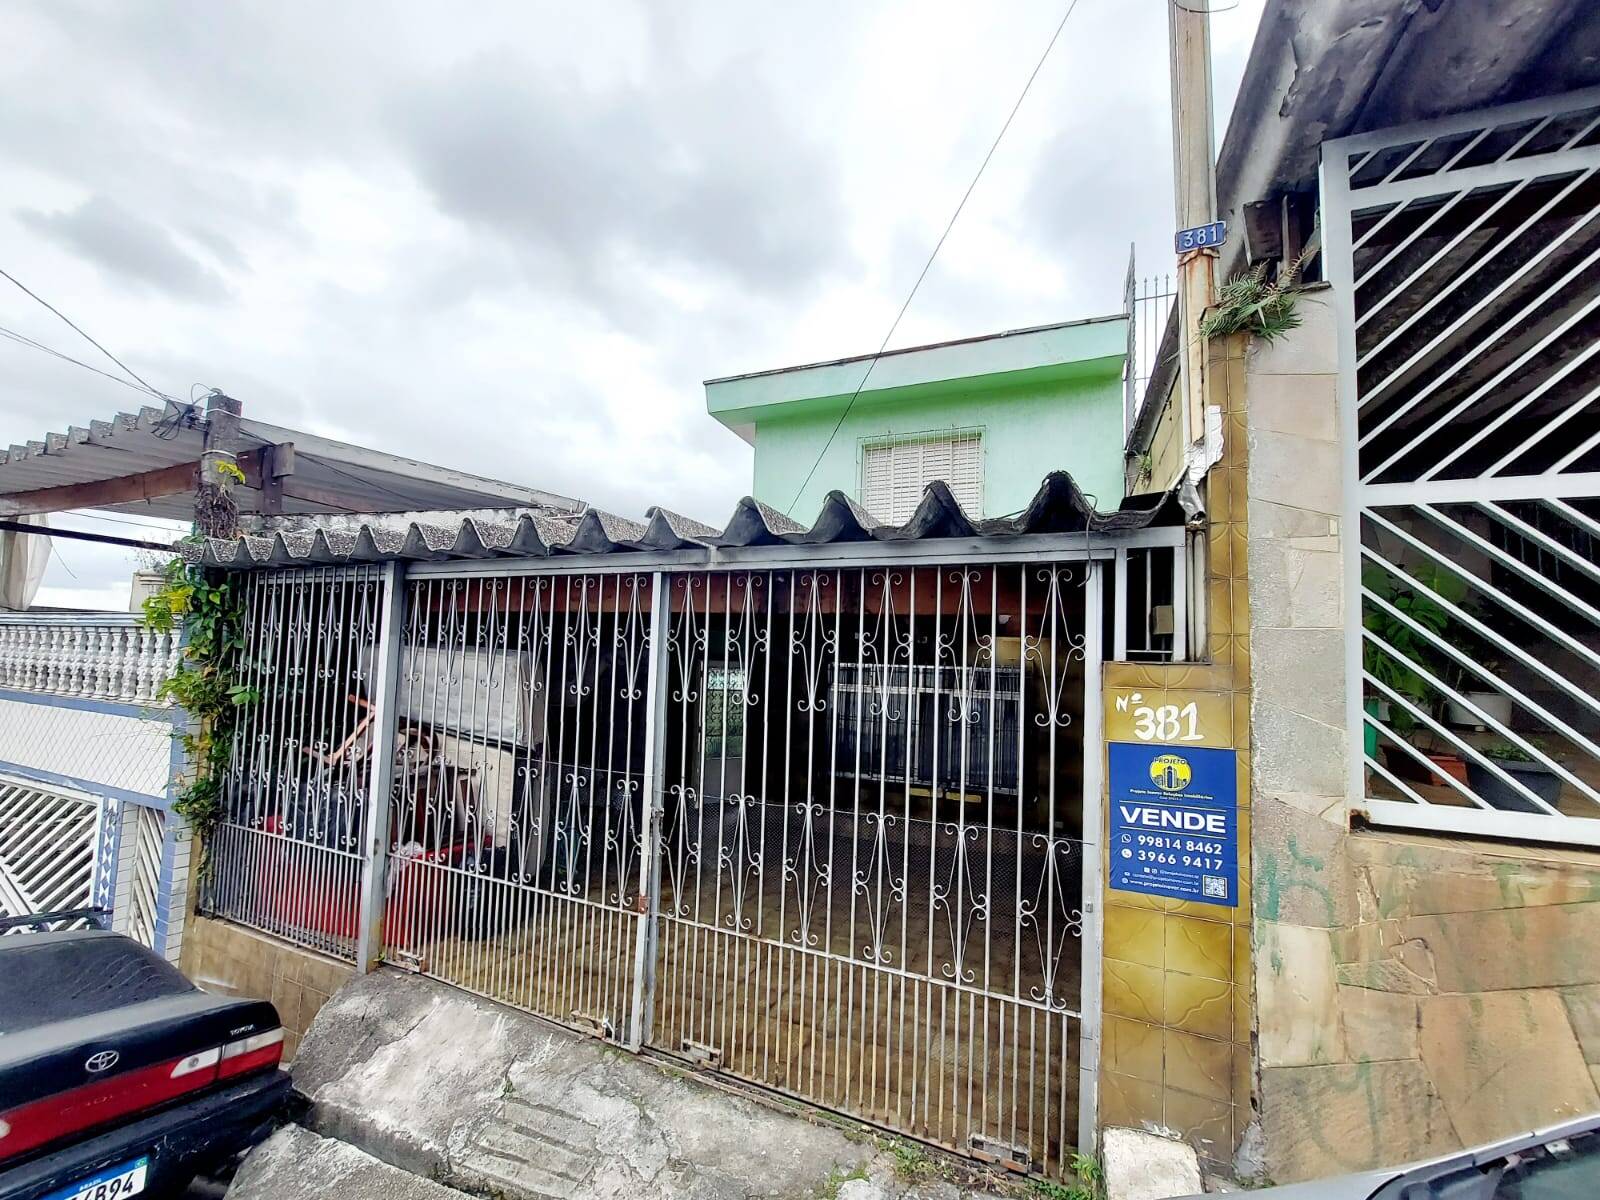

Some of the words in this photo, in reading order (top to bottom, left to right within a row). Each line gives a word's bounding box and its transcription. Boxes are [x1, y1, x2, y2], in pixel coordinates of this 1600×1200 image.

[1184, 225, 1217, 247] 381
[1134, 702, 1205, 740] 381
[1153, 756, 1187, 765] PROJETO
[1120, 806, 1226, 833] VENDE
[1138, 835, 1181, 850] 99814
[1186, 841, 1222, 855] 8462
[1138, 850, 1177, 865] 3966
[1182, 855, 1223, 870] 9417
